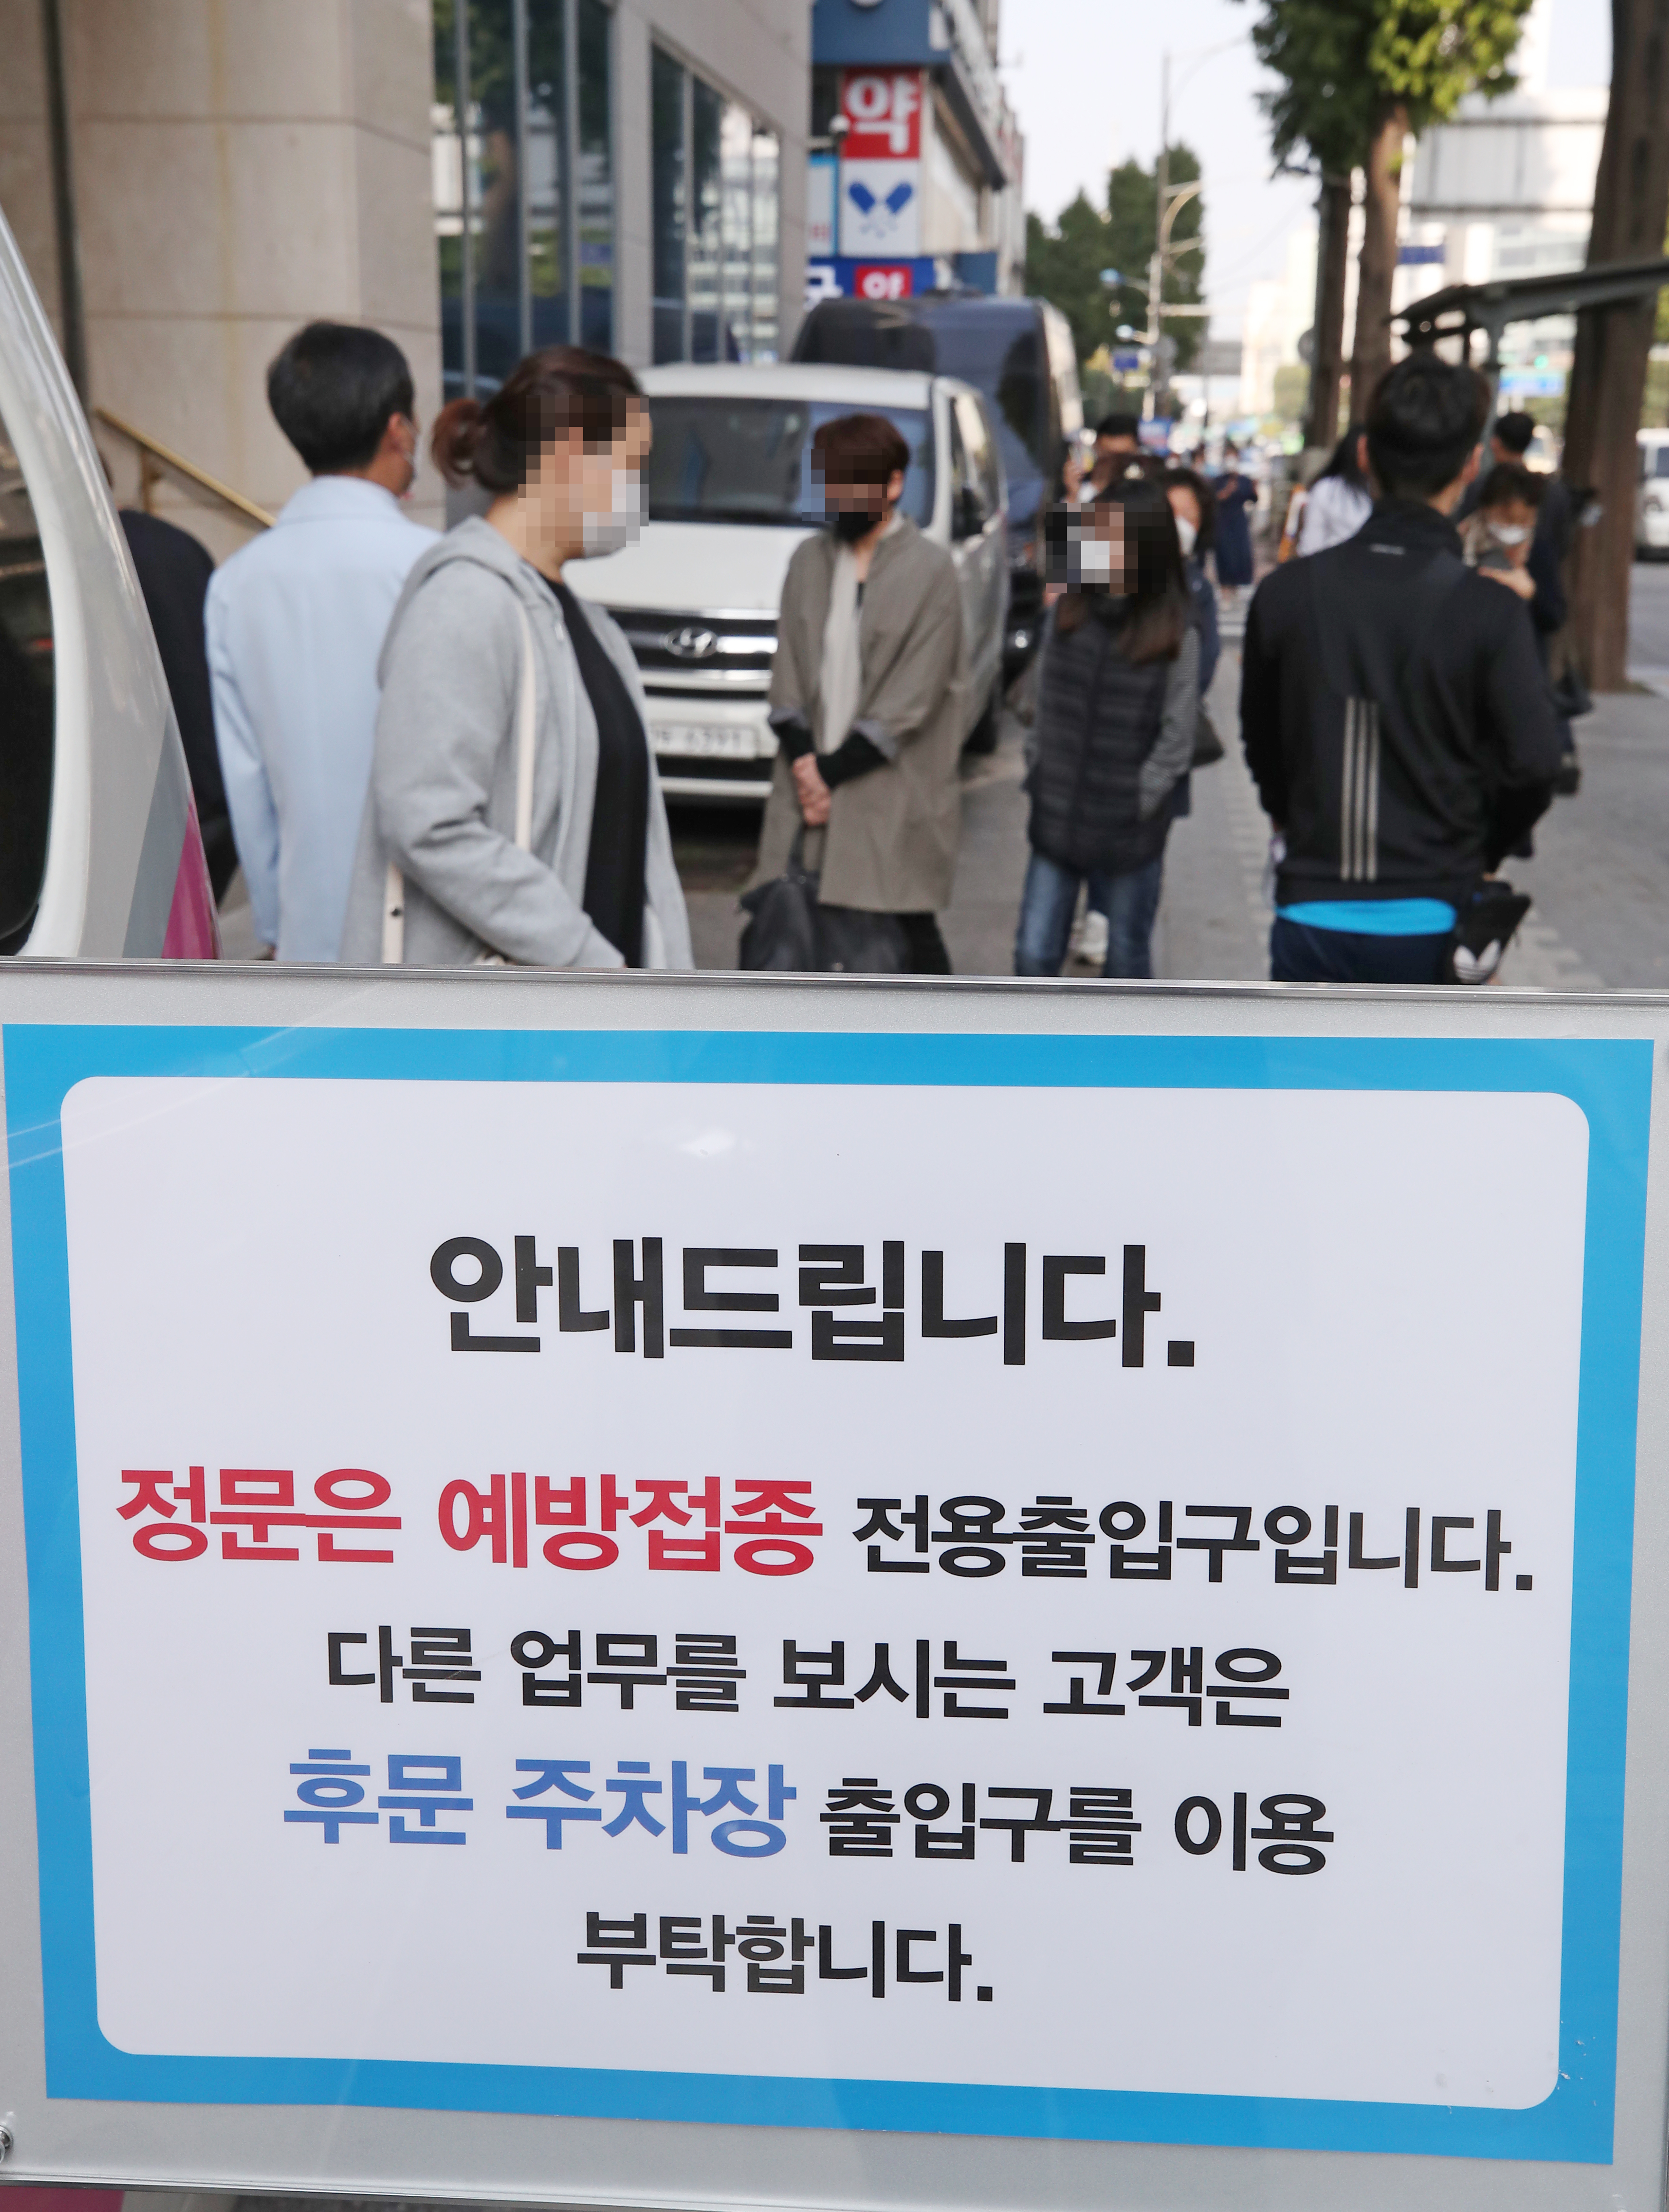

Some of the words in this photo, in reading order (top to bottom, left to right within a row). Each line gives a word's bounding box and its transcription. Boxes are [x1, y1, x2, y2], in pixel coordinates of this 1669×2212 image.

[846, 76, 919, 155] 약
[430, 1235, 1194, 1367] 안내드립니다.
[116, 1466, 401, 1563] 정문은
[439, 1473, 823, 1576] 예방접종
[852, 1495, 1532, 1591] 전용출입구입니다.
[328, 1626, 481, 1703] 다른
[511, 1630, 746, 1712] 업무를
[774, 1640, 1016, 1719] 보시는
[1044, 1647, 1289, 1727] 고객은
[284, 1749, 473, 1845] 후문
[506, 1759, 797, 1858] 주차장
[820, 1778, 1141, 1865] 출입구를
[1174, 1792, 1334, 1875] 이용
[578, 1912, 992, 2001] 부탁합니다.
